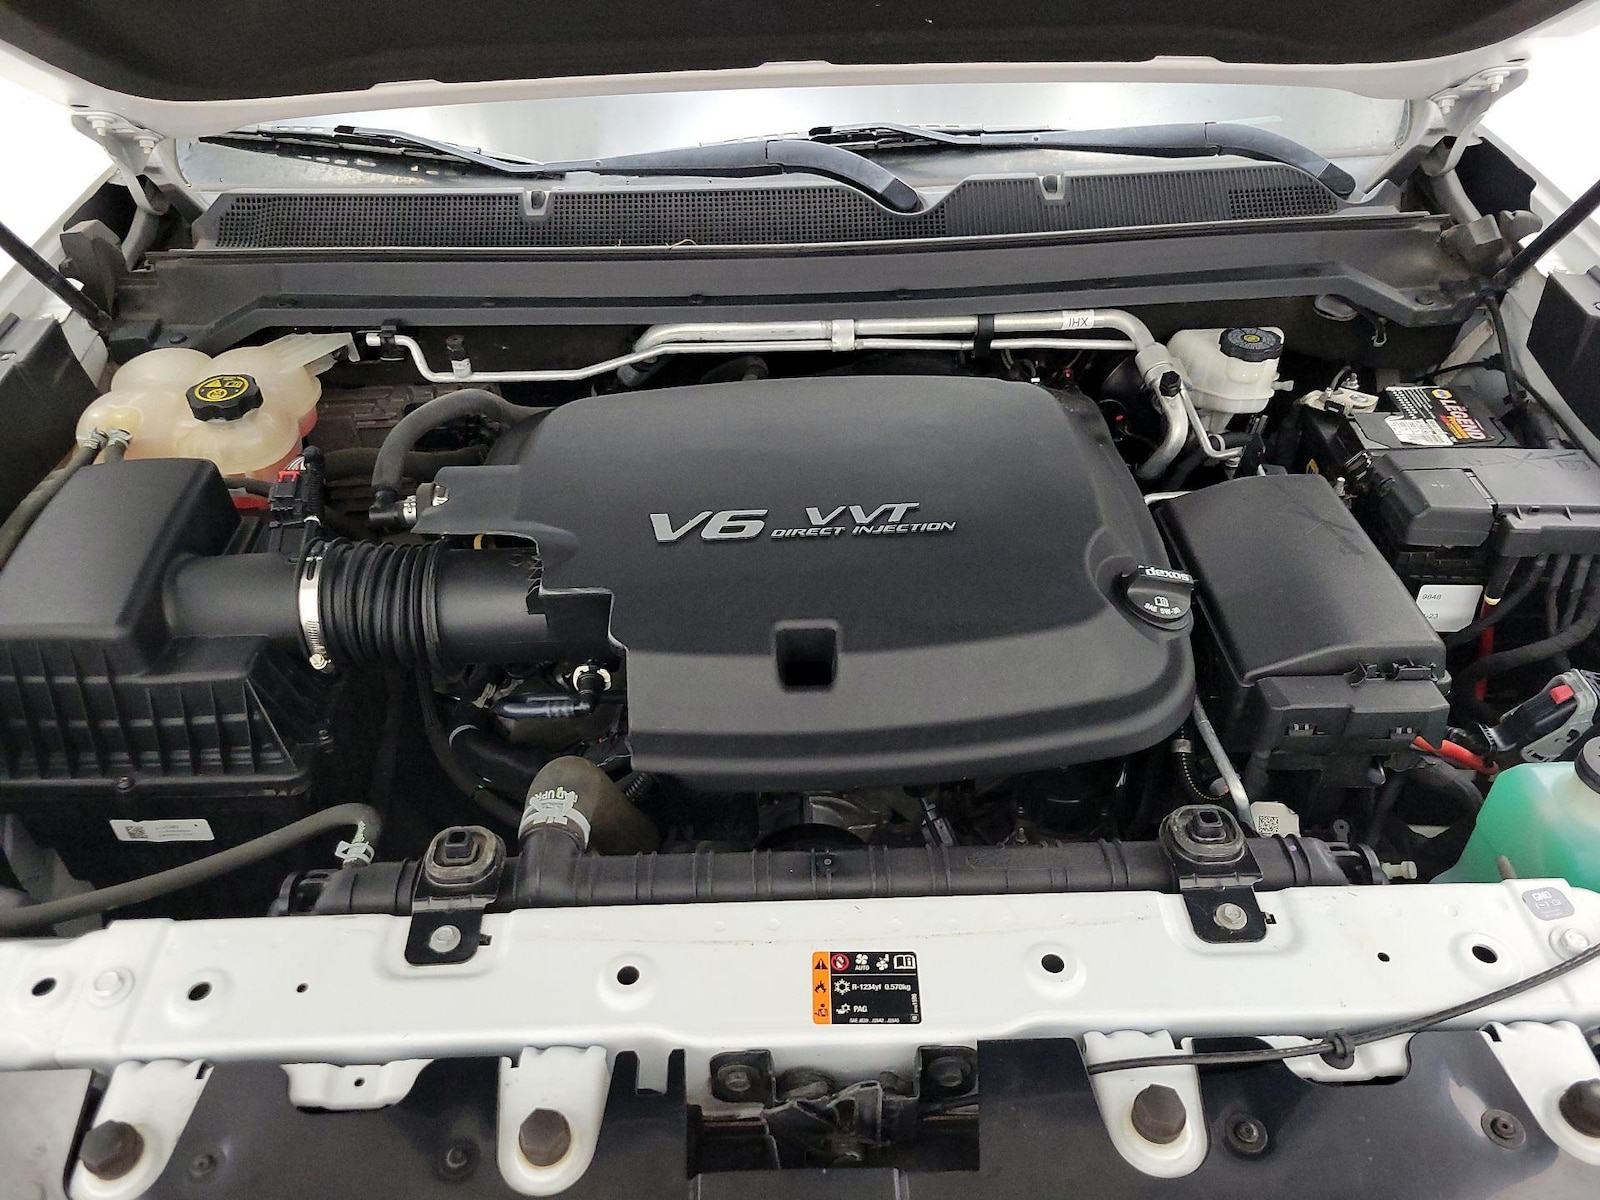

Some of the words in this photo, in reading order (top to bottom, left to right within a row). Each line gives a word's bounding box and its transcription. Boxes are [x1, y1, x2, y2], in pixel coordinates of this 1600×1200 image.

[805, 502, 920, 526] VVT
[649, 509, 769, 543] V6
[769, 526, 846, 539] DIRECT
[851, 521, 957, 537] INJECTION
[1145, 566, 1190, 582] dexos
[851, 983, 882, 992] R-1234yf
[884, 983, 911, 992] 0.570kg
[853, 1005, 868, 1013] PAG
